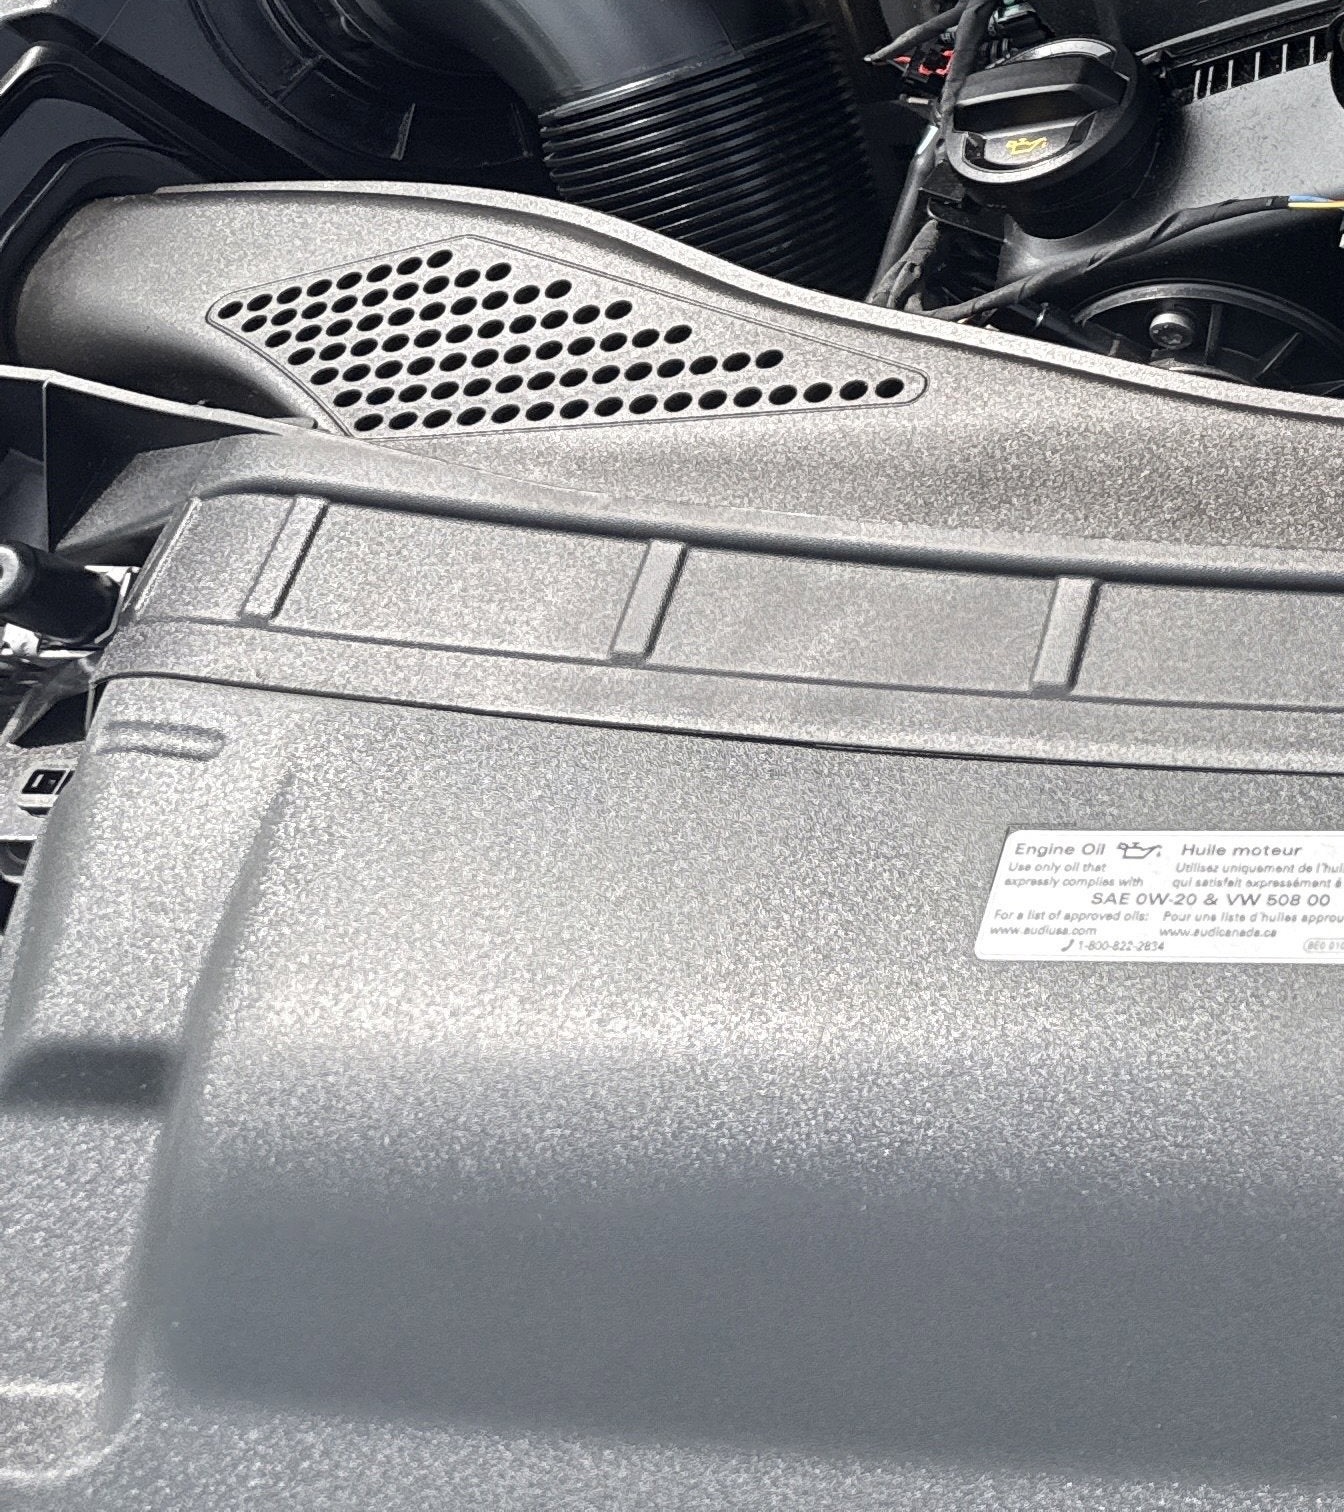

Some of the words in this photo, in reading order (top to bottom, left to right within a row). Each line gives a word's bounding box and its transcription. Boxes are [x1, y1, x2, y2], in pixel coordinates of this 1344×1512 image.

[1014, 842, 1076, 858] Engine
[1081, 842, 1106, 856] Oil
[1180, 843, 1227, 856] Huile
[1231, 845, 1303, 857] moteur
[1008, 862, 1032, 872] Use
[1034, 862, 1062, 874] only
[1063, 861, 1081, 873] oil
[1082, 861, 1108, 873] that
[1175, 862, 1220, 874] Utilisez
[1221, 864, 1295, 875] uniquement
[1297, 862, 1313, 874] de
[1004, 876, 1061, 889] expressly
[1061, 876, 1115, 889] complies
[1118, 875, 1144, 887] with
[1171, 877, 1193, 890] qui
[1194, 876, 1243, 888] satisfait
[1090, 892, 1131, 905] SAE
[1135, 892, 1198, 906] 0W-20
[1202, 892, 1219, 907] &
[1226, 893, 1262, 907] VW
[1265, 893, 1302, 907] 508
[1306, 893, 1331, 907] 00
[993, 908, 1015, 921] For
[1016, 911, 1024, 921] a
[1026, 909, 1046, 921] list
[1047, 909, 1062, 921] of
[1063, 910, 1122, 923] approved
[1123, 910, 1150, 922] oils:
[1162, 910, 1192, 922] Pour
[1194, 913, 1217, 923] une
[1220, 911, 1246, 923] liste
[989, 924, 1097, 936] www.audiusa.com
[1078, 940, 1165, 952] 1-800-822-2834
